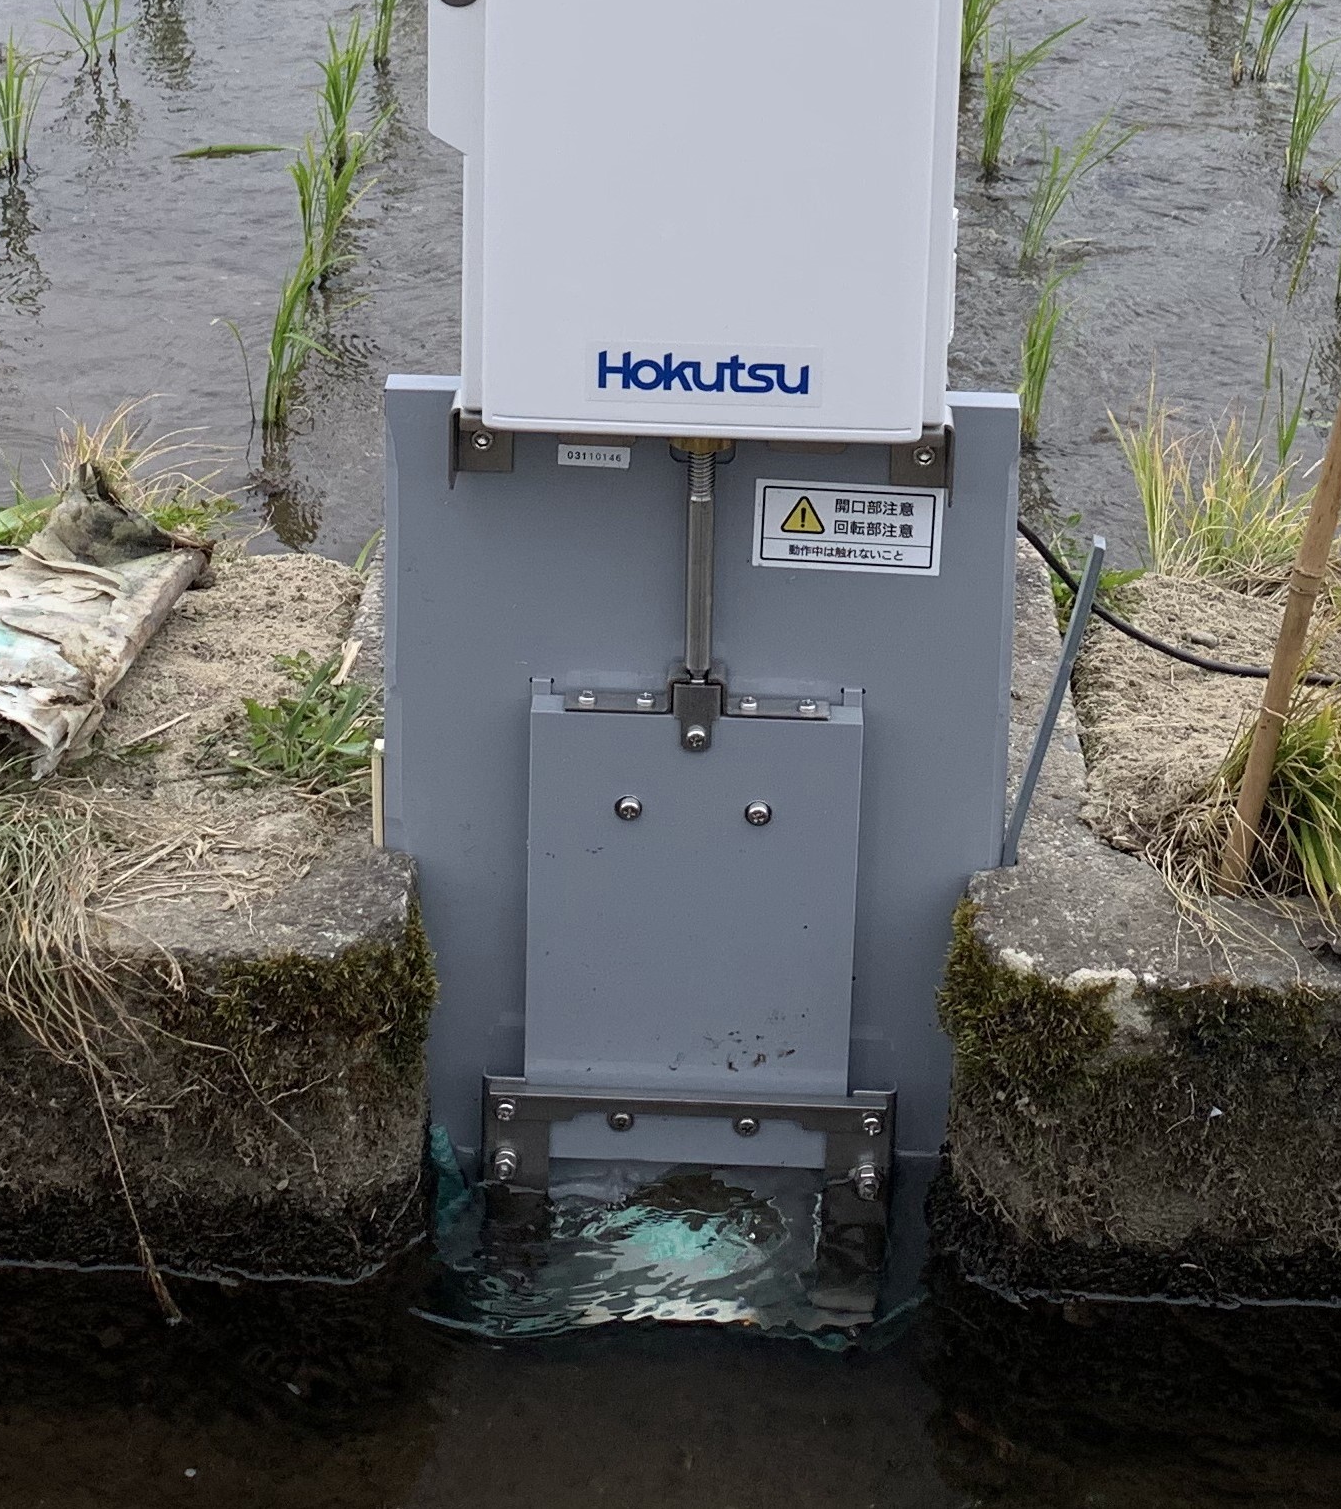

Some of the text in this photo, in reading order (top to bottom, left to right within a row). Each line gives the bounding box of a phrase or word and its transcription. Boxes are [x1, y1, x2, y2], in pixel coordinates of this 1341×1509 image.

[597, 350, 809, 395] Hokutsu
[567, 450, 622, 462] 03110146
[834, 498, 914, 517] 開口部注意
[833, 519, 914, 539] 回転部注意
[788, 544, 904, 562] 動作中は触れないこと
